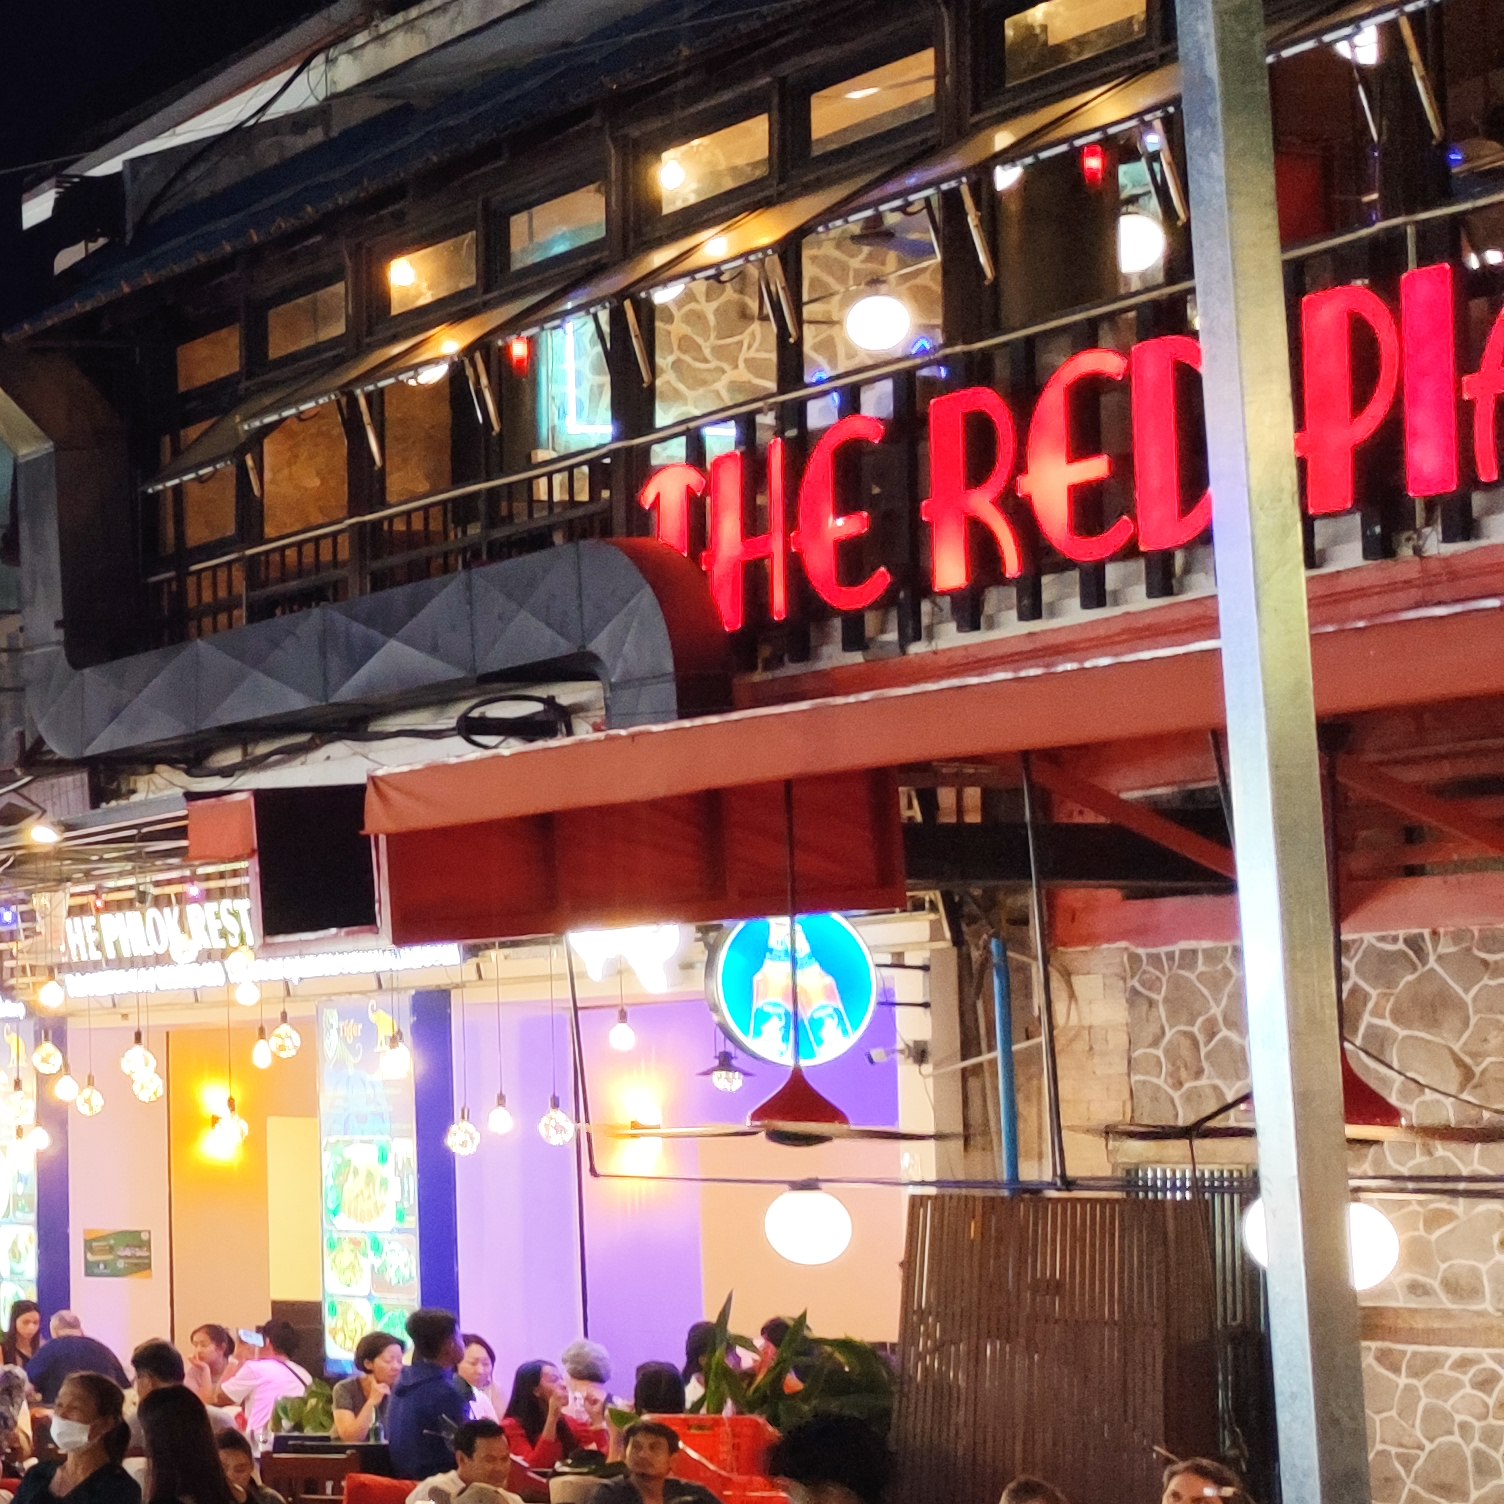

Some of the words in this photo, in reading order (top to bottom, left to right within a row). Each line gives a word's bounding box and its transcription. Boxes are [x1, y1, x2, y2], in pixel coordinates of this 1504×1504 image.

[640, 413, 892, 634] THE
[921, 334, 1212, 596] RED
[59, 915, 103, 963] HE
